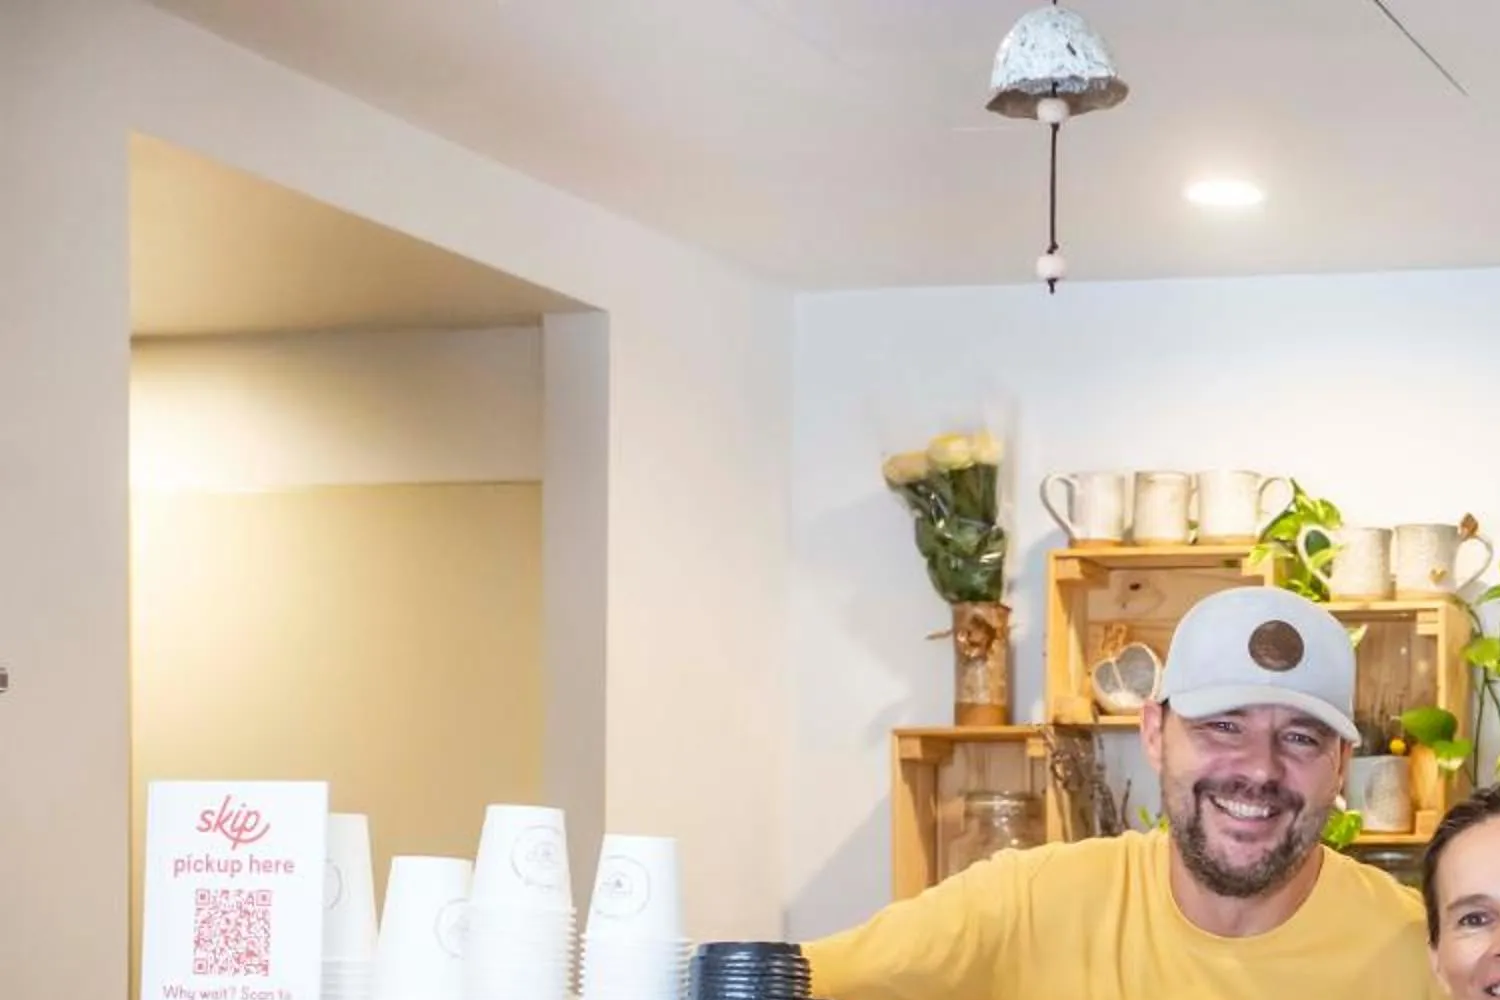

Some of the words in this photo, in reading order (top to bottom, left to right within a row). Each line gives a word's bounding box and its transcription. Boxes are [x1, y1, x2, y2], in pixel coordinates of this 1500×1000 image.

[196, 794, 271, 850] skip
[174, 853, 243, 878] pickup
[249, 853, 296, 873] here
[199, 985, 237, 1000] wait?
[241, 987, 275, 1000] Scan
[279, 989, 293, 1000] to
